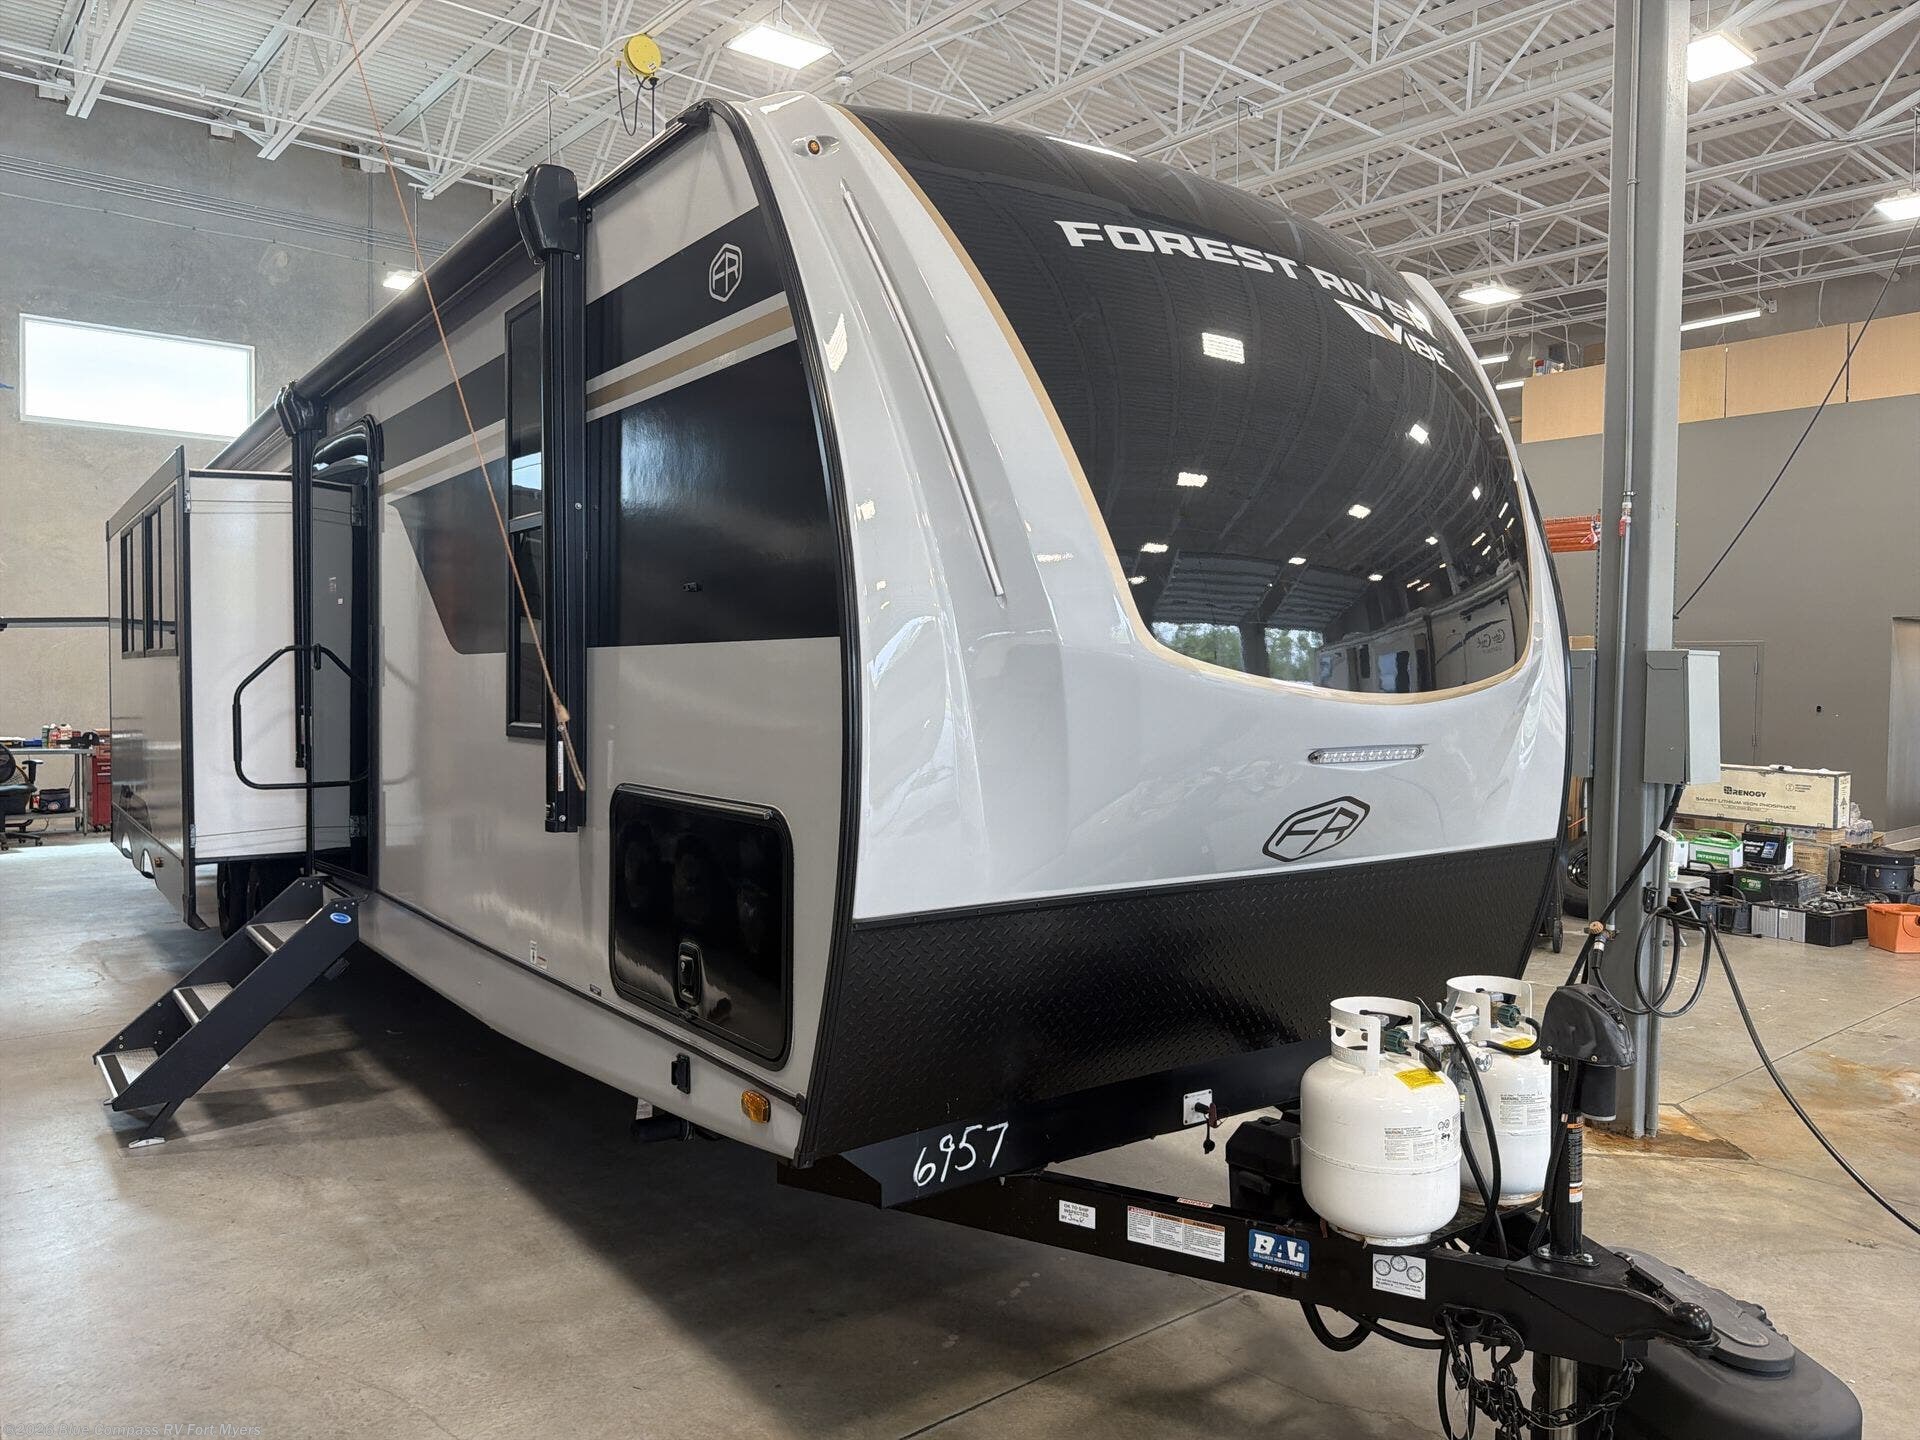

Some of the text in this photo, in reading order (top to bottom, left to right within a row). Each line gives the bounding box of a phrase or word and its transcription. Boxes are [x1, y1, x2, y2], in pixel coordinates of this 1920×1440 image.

[1054, 220, 1439, 341] FOREST RIVER
[1334, 298, 1455, 373] VIBE
[1732, 789, 1767, 798] RENOGY
[1696, 853, 1729, 862] INTERSTATE
[912, 1120, 1010, 1188] 6957
[1253, 1233, 1305, 1263] BAL
